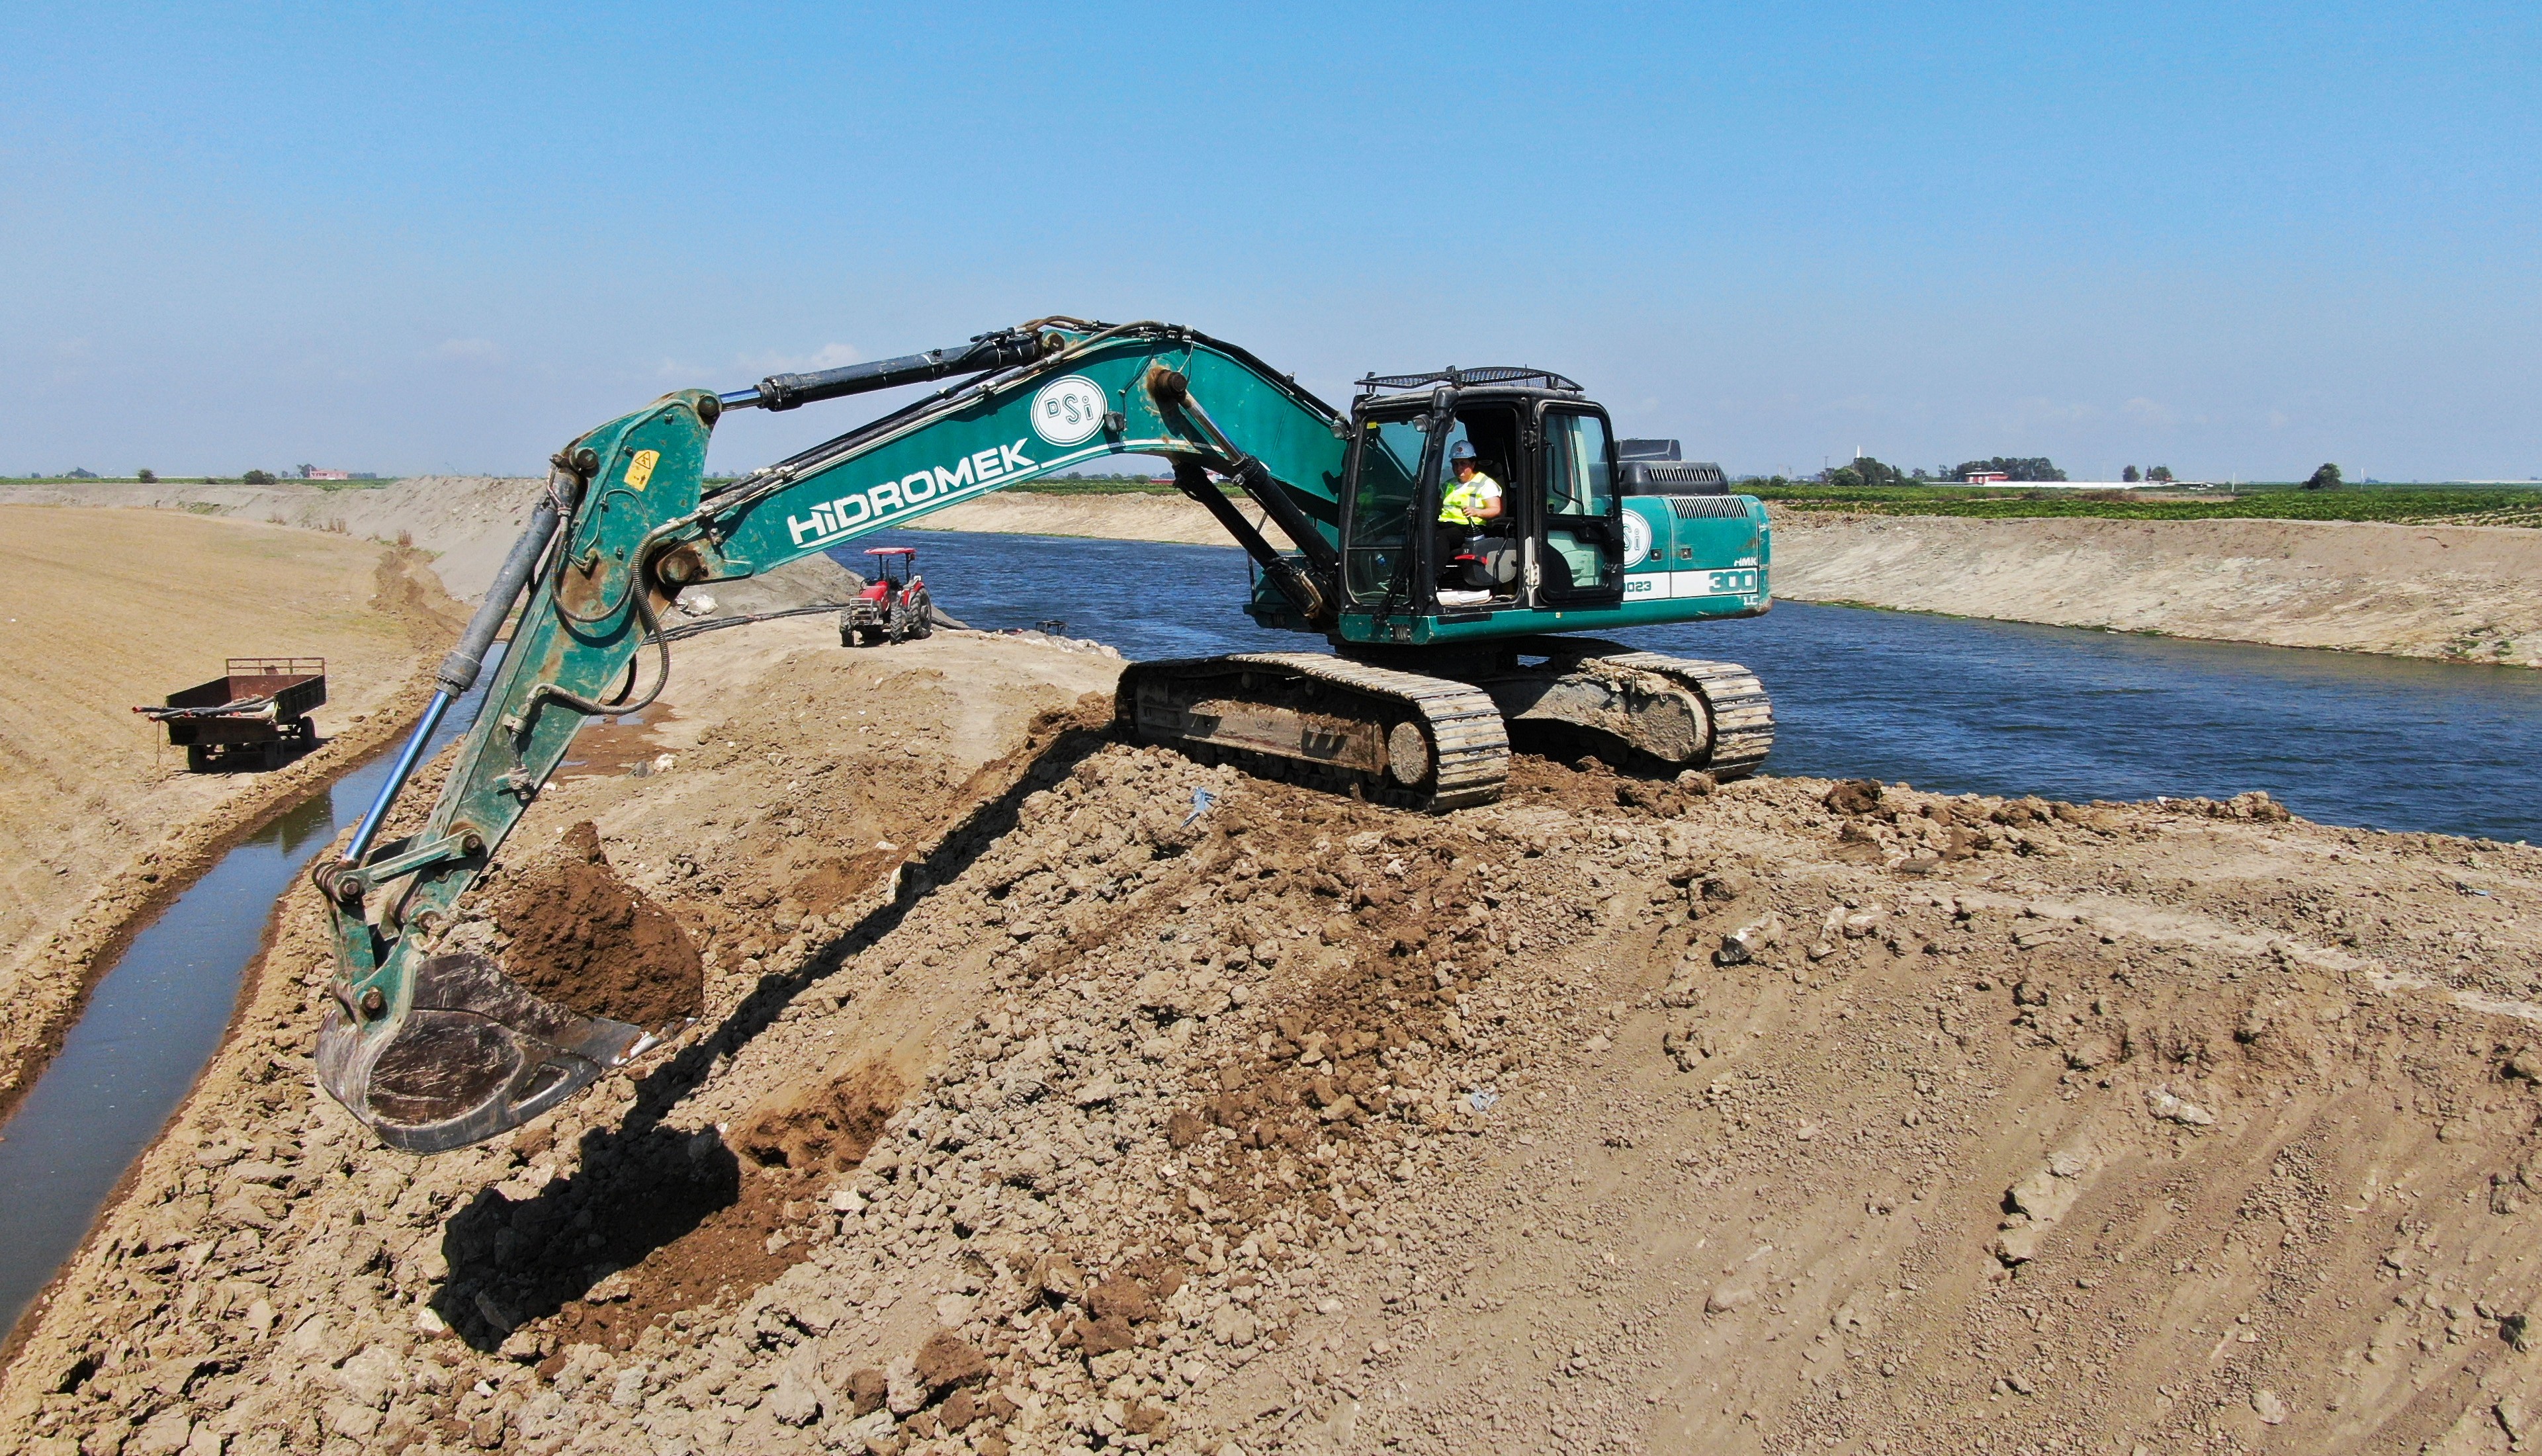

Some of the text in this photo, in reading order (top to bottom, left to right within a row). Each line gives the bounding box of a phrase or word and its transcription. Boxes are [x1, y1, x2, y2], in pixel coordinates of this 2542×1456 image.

[1733, 556, 1758, 567] HMK
[1623, 581, 1651, 593] 023
[1709, 570, 1757, 593] 300
